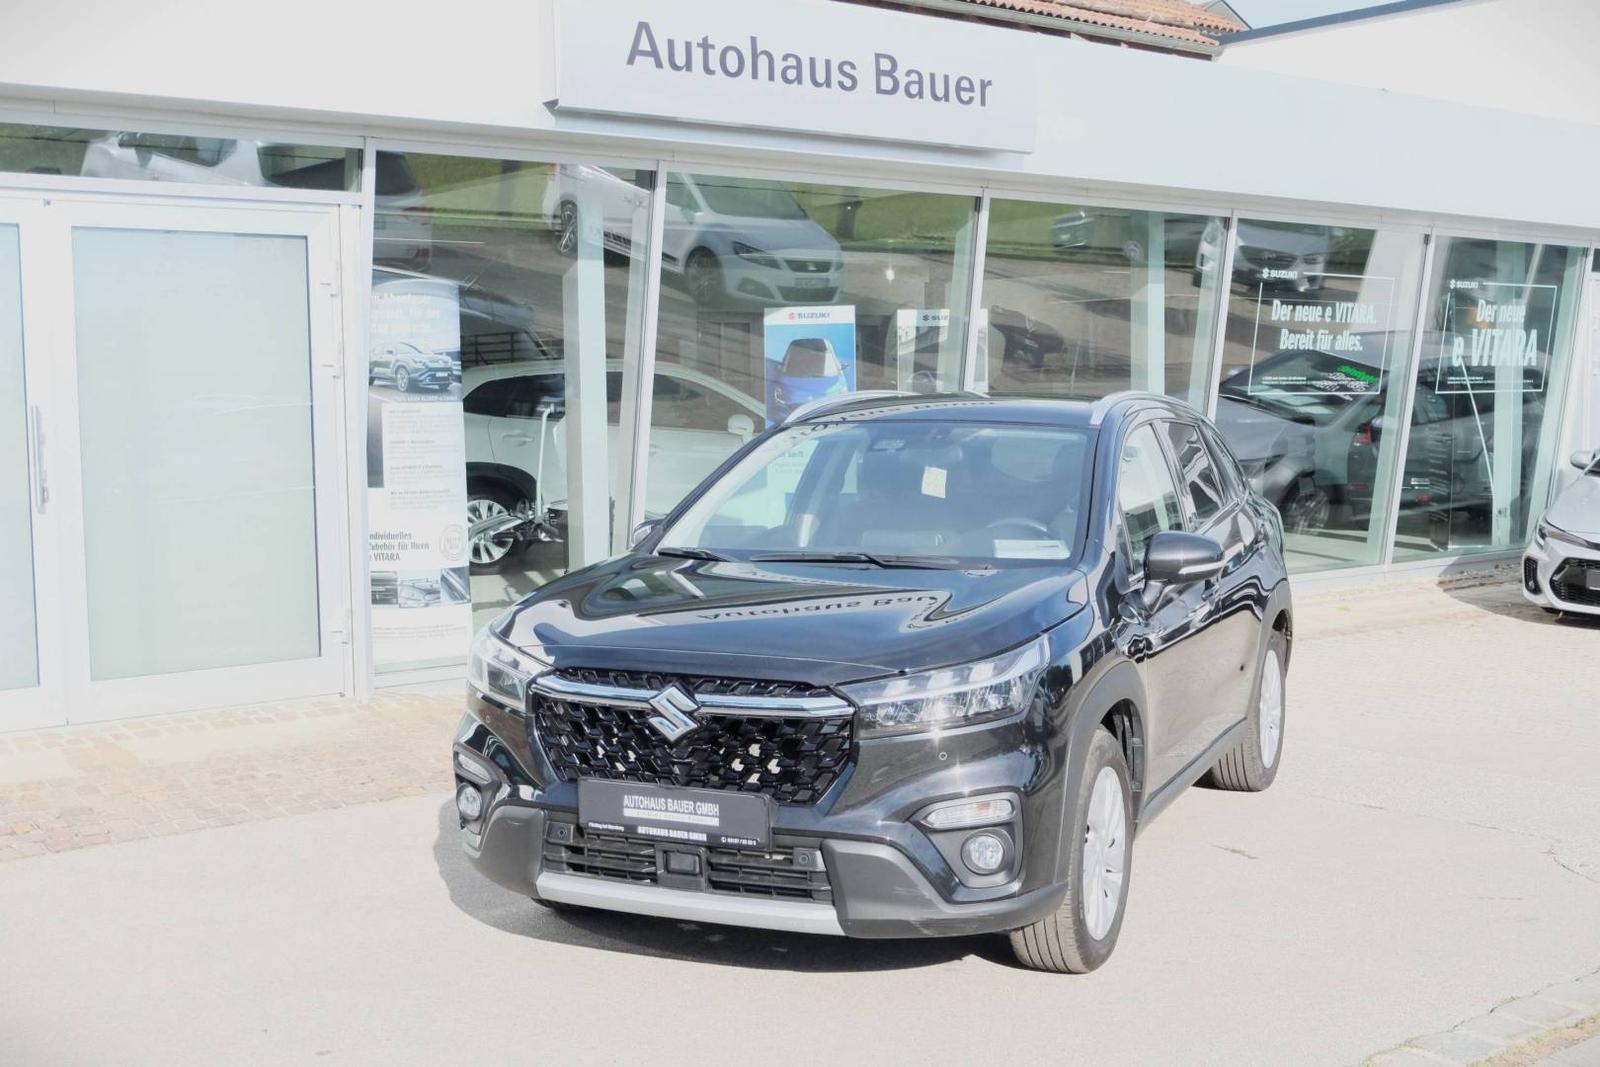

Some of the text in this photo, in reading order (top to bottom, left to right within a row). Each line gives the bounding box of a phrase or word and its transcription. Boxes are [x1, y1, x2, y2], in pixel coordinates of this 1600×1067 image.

[626, 20, 993, 108] Autohaus Bauer
[1270, 269, 1298, 280] SUZUKI
[798, 312, 831, 321] SUZUKI
[1272, 299, 1377, 324] Der neue e VITARA.
[1476, 299, 1526, 323] Der neue
[1279, 328, 1364, 351] Bereit für alles.
[1471, 328, 1538, 367] VITARA
[369, 531, 412, 541] ndividuelles
[373, 552, 401, 562] VITARA
[623, 794, 667, 812] AUTOHAUS
[667, 798, 696, 814] BAUER
[696, 802, 720, 817] GMBH
[637, 826, 669, 837] AUTOHAUS
